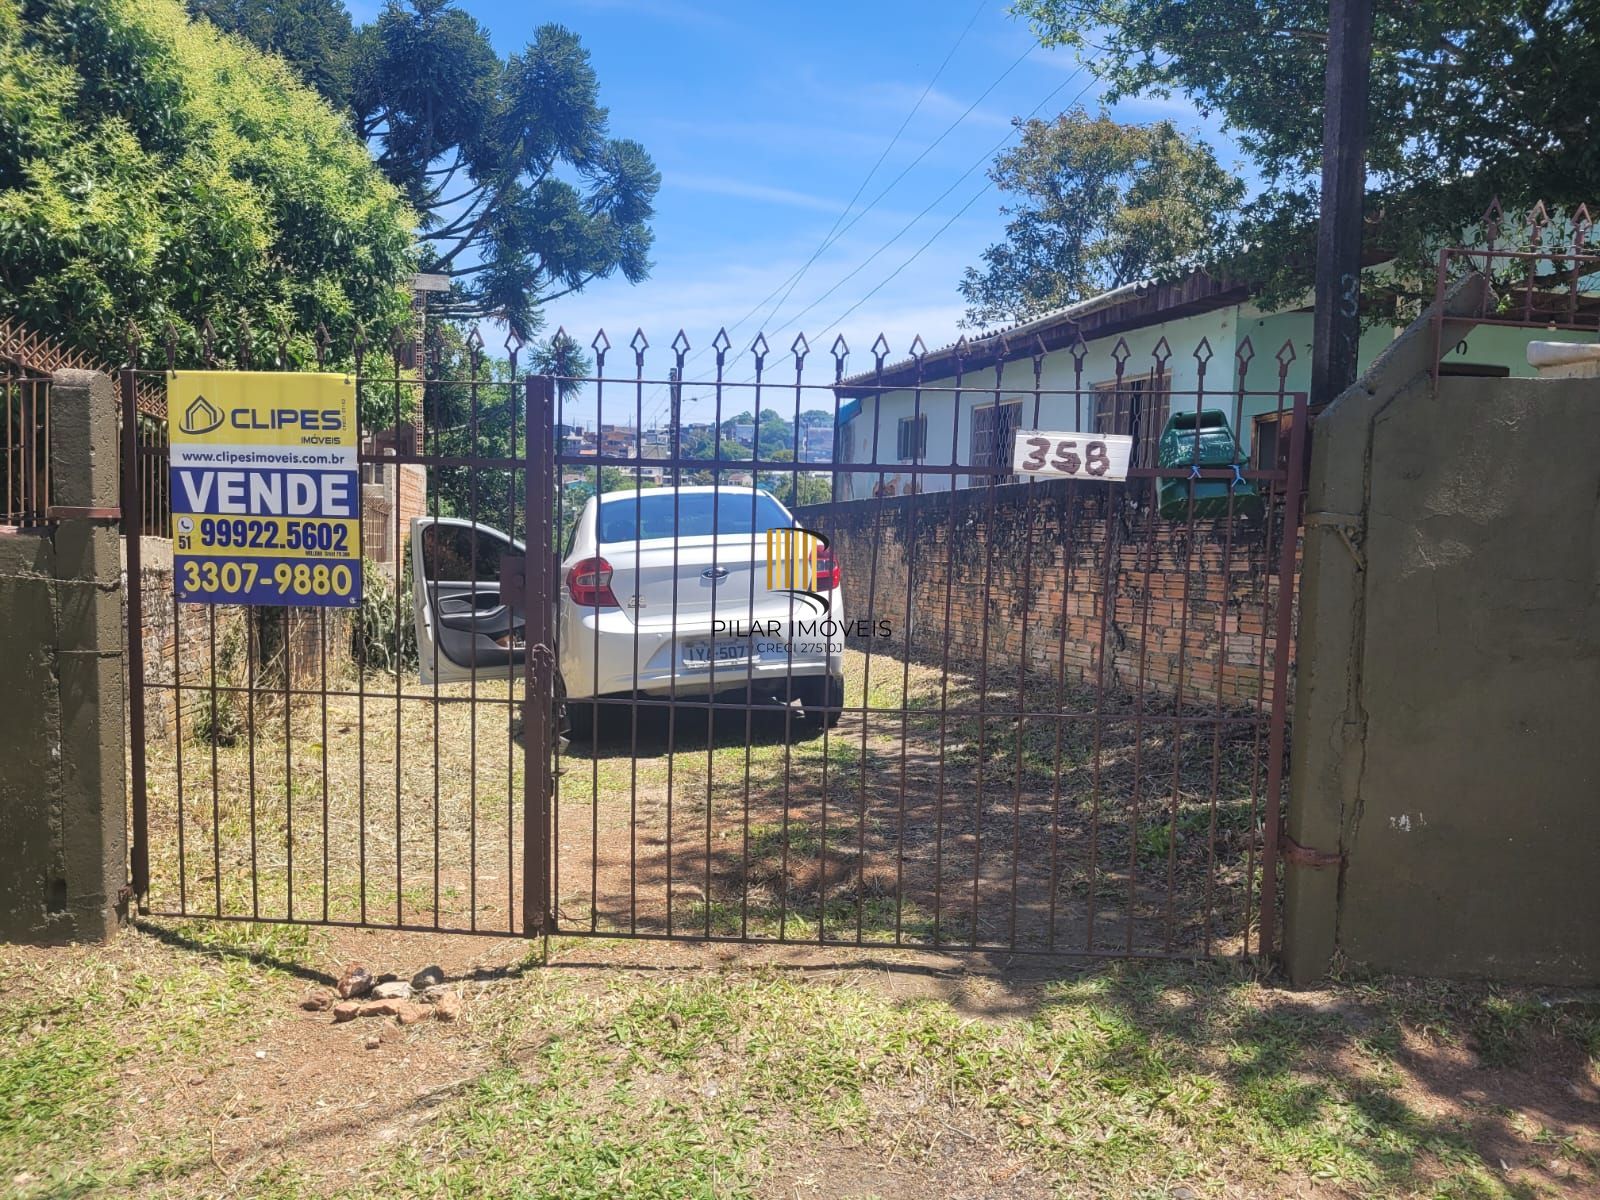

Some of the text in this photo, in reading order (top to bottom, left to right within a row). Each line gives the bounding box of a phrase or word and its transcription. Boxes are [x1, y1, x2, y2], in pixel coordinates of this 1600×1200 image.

[231, 408, 342, 431] CLIPES
[301, 434, 341, 445] IMÓVEIS
[182, 451, 345, 465] www.clipesimoveis.com.br
[1022, 437, 1110, 476] 358
[180, 470, 350, 516] VENDE
[178, 535, 192, 550] 51
[200, 518, 348, 551] 99922.5602
[183, 560, 352, 596] 3307-9880
